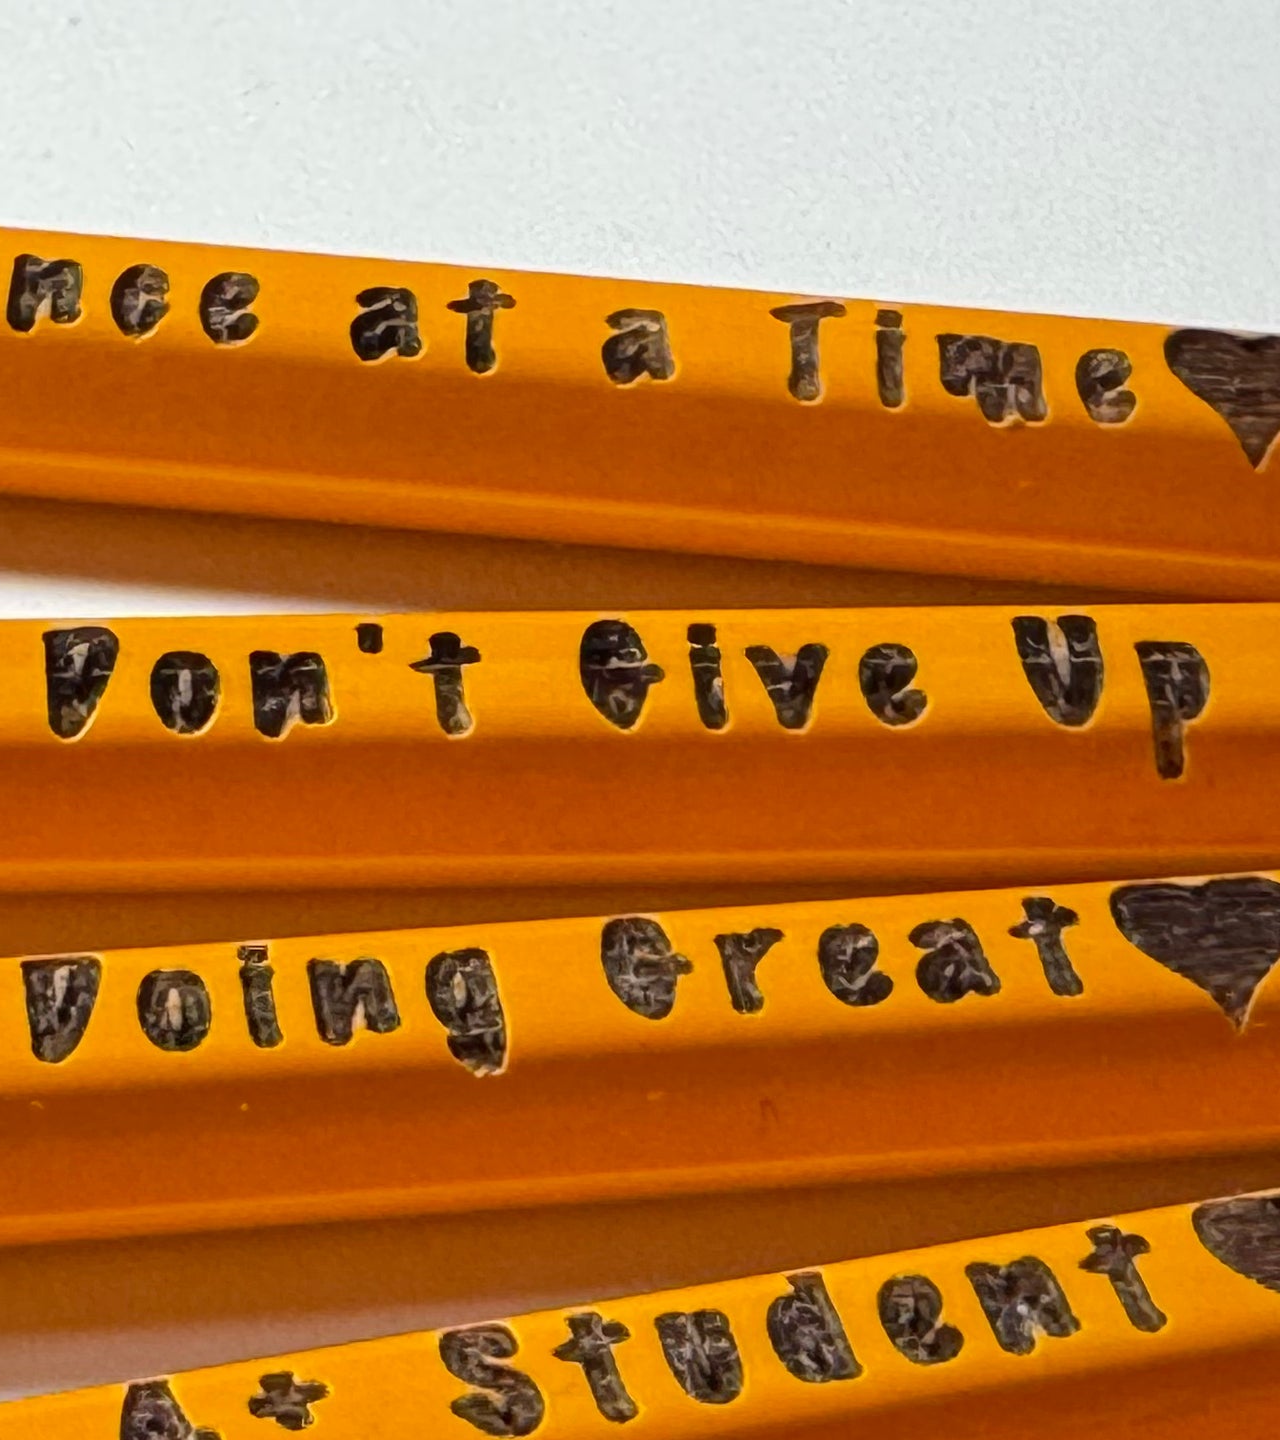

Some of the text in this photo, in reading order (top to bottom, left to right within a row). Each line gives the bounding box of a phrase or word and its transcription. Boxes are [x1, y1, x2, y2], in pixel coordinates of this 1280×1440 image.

[350, 280, 517, 375] at
[602, 309, 674, 386] a
[771, 301, 1135, 425] Time
[43, 623, 482, 738] Don't
[580, 619, 927, 730] Give
[22, 945, 508, 1074] Doing
[600, 896, 1083, 1017] Great
[439, 1225, 1166, 1436] Student
